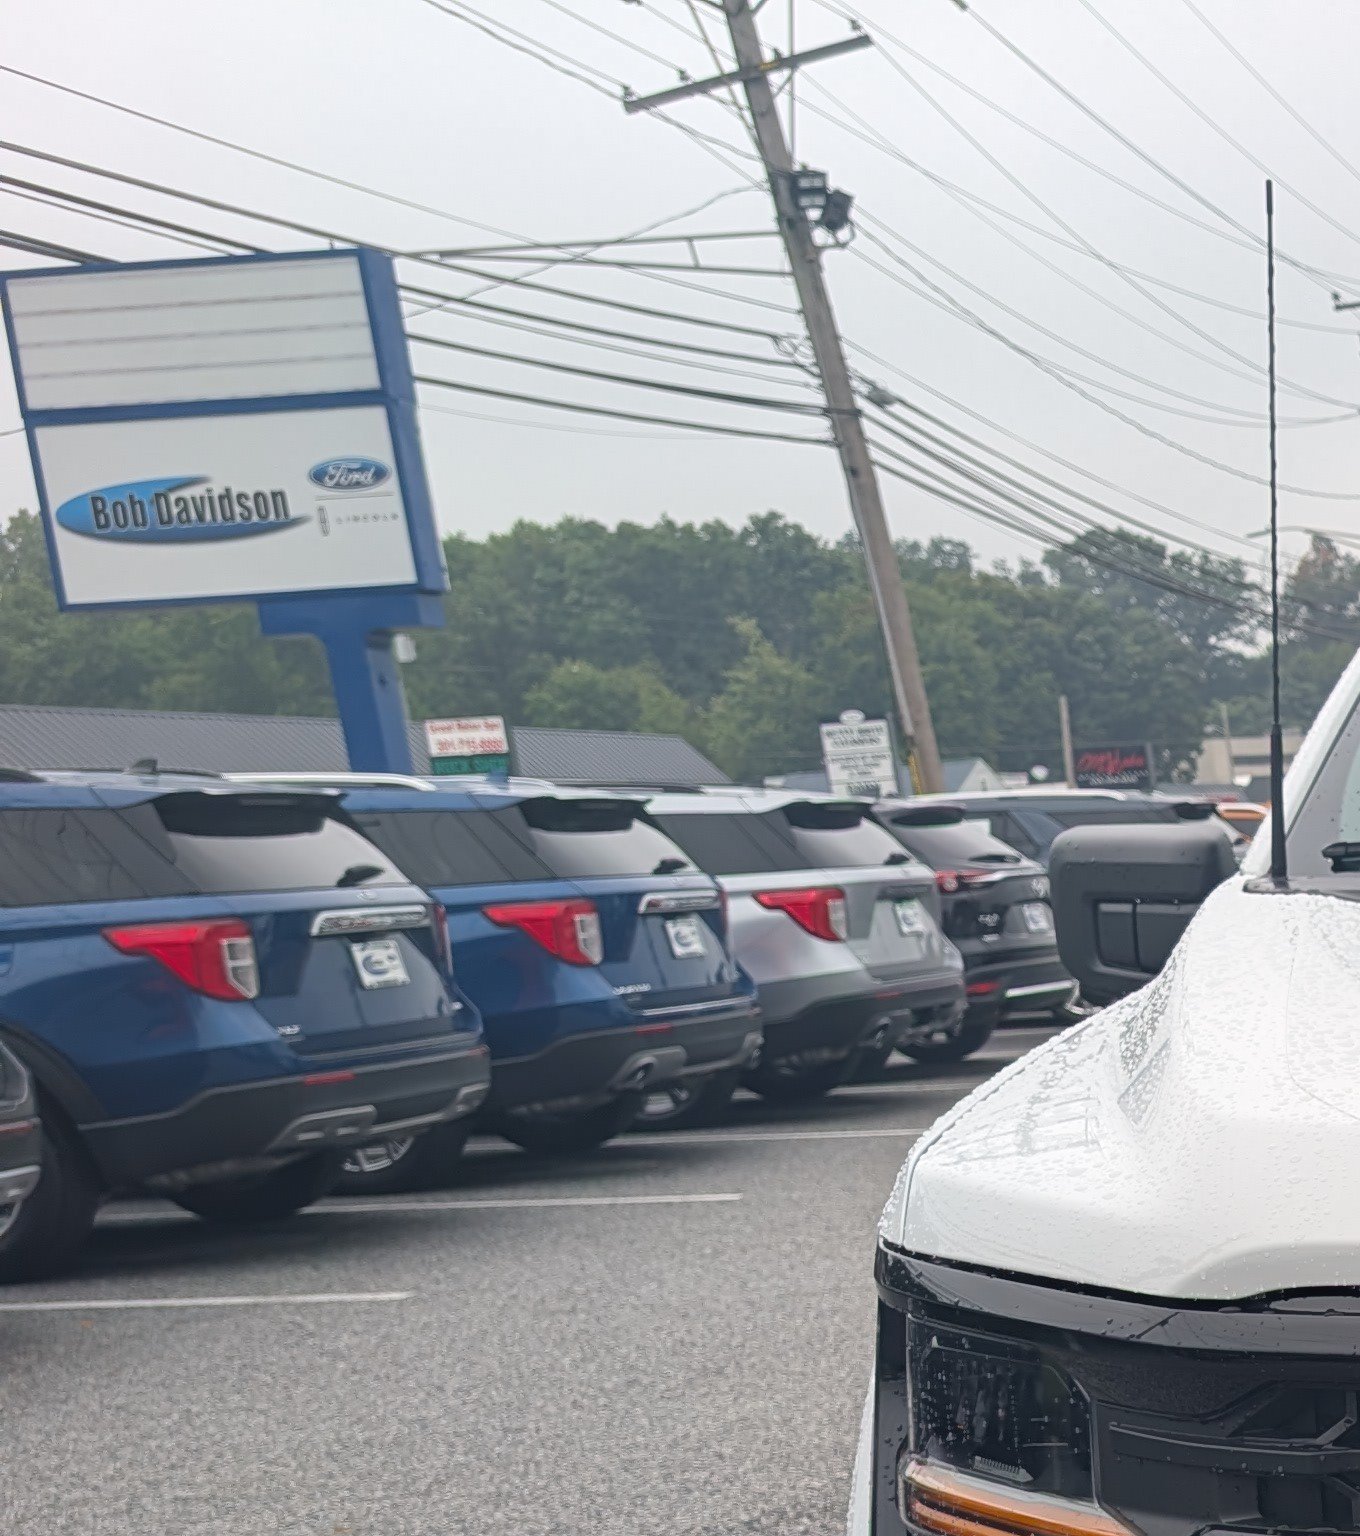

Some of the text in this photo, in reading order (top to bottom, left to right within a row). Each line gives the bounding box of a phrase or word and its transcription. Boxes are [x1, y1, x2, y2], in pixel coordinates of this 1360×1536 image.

[324, 463, 376, 487] Ford
[90, 487, 291, 530] Bob Davidson
